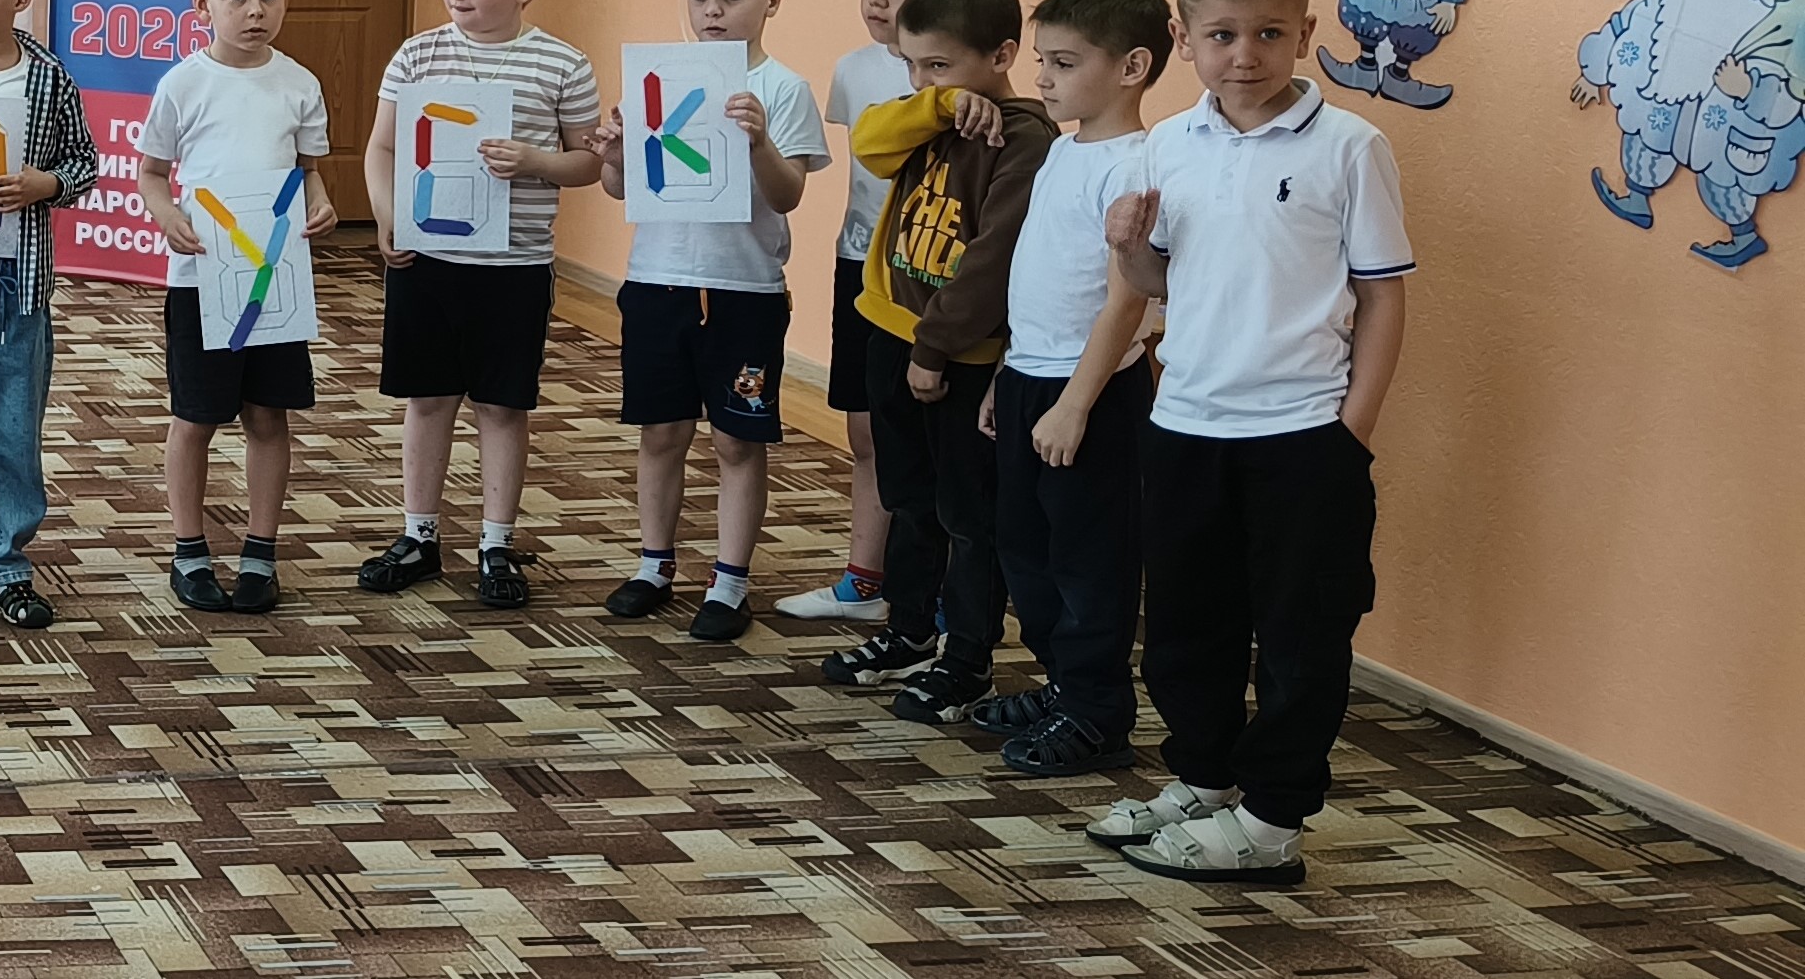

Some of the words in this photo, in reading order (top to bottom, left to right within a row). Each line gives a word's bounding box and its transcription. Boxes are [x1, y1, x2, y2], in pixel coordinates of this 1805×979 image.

[69, 1, 212, 62] 2026
[109, 118, 145, 147] ГО
[75, 221, 170, 257] РОССИ
